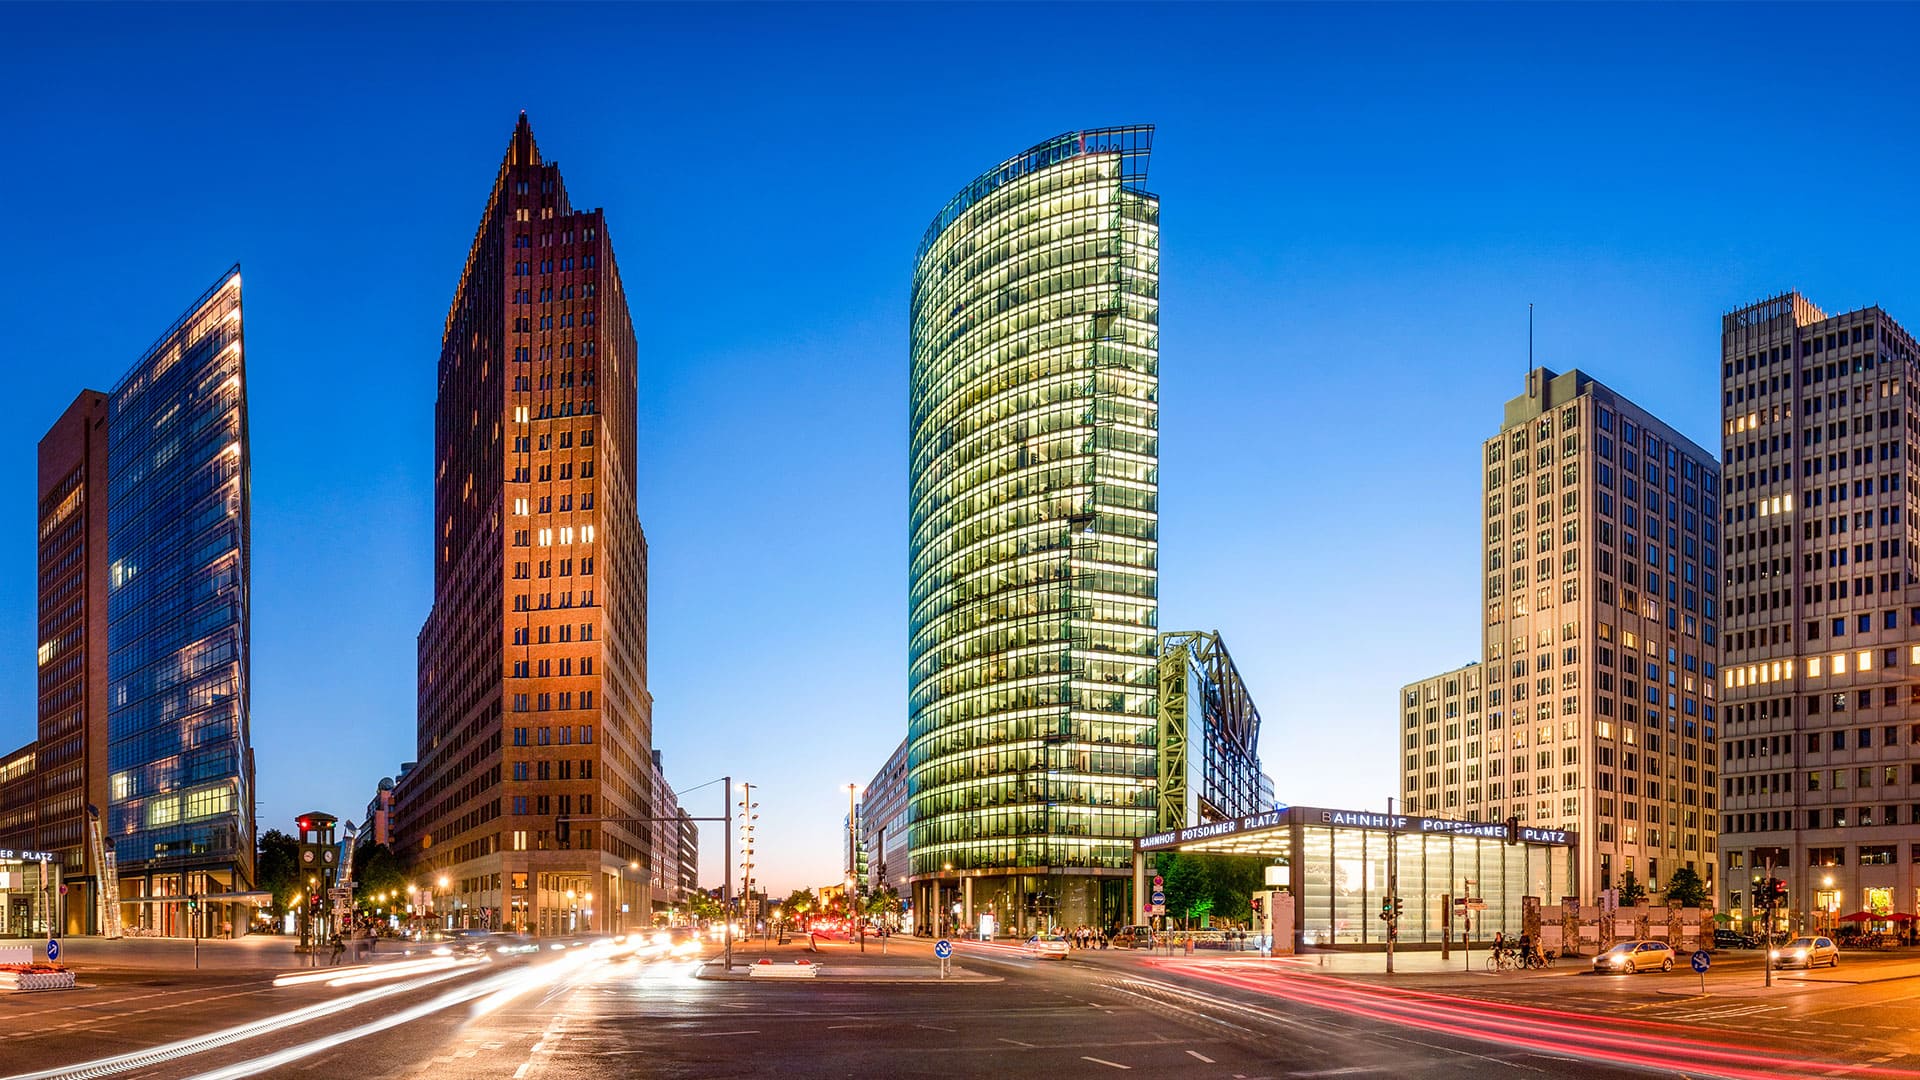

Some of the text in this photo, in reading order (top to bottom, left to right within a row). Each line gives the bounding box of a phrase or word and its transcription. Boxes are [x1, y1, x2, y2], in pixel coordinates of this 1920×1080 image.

[1140, 813, 1279, 848] BAHNHOF POTSDAMER PLATZ
[1322, 811, 1408, 829] BAHNHOF
[1525, 829, 1566, 843] PLATZ
[22, 851, 53, 861] PLATZ
